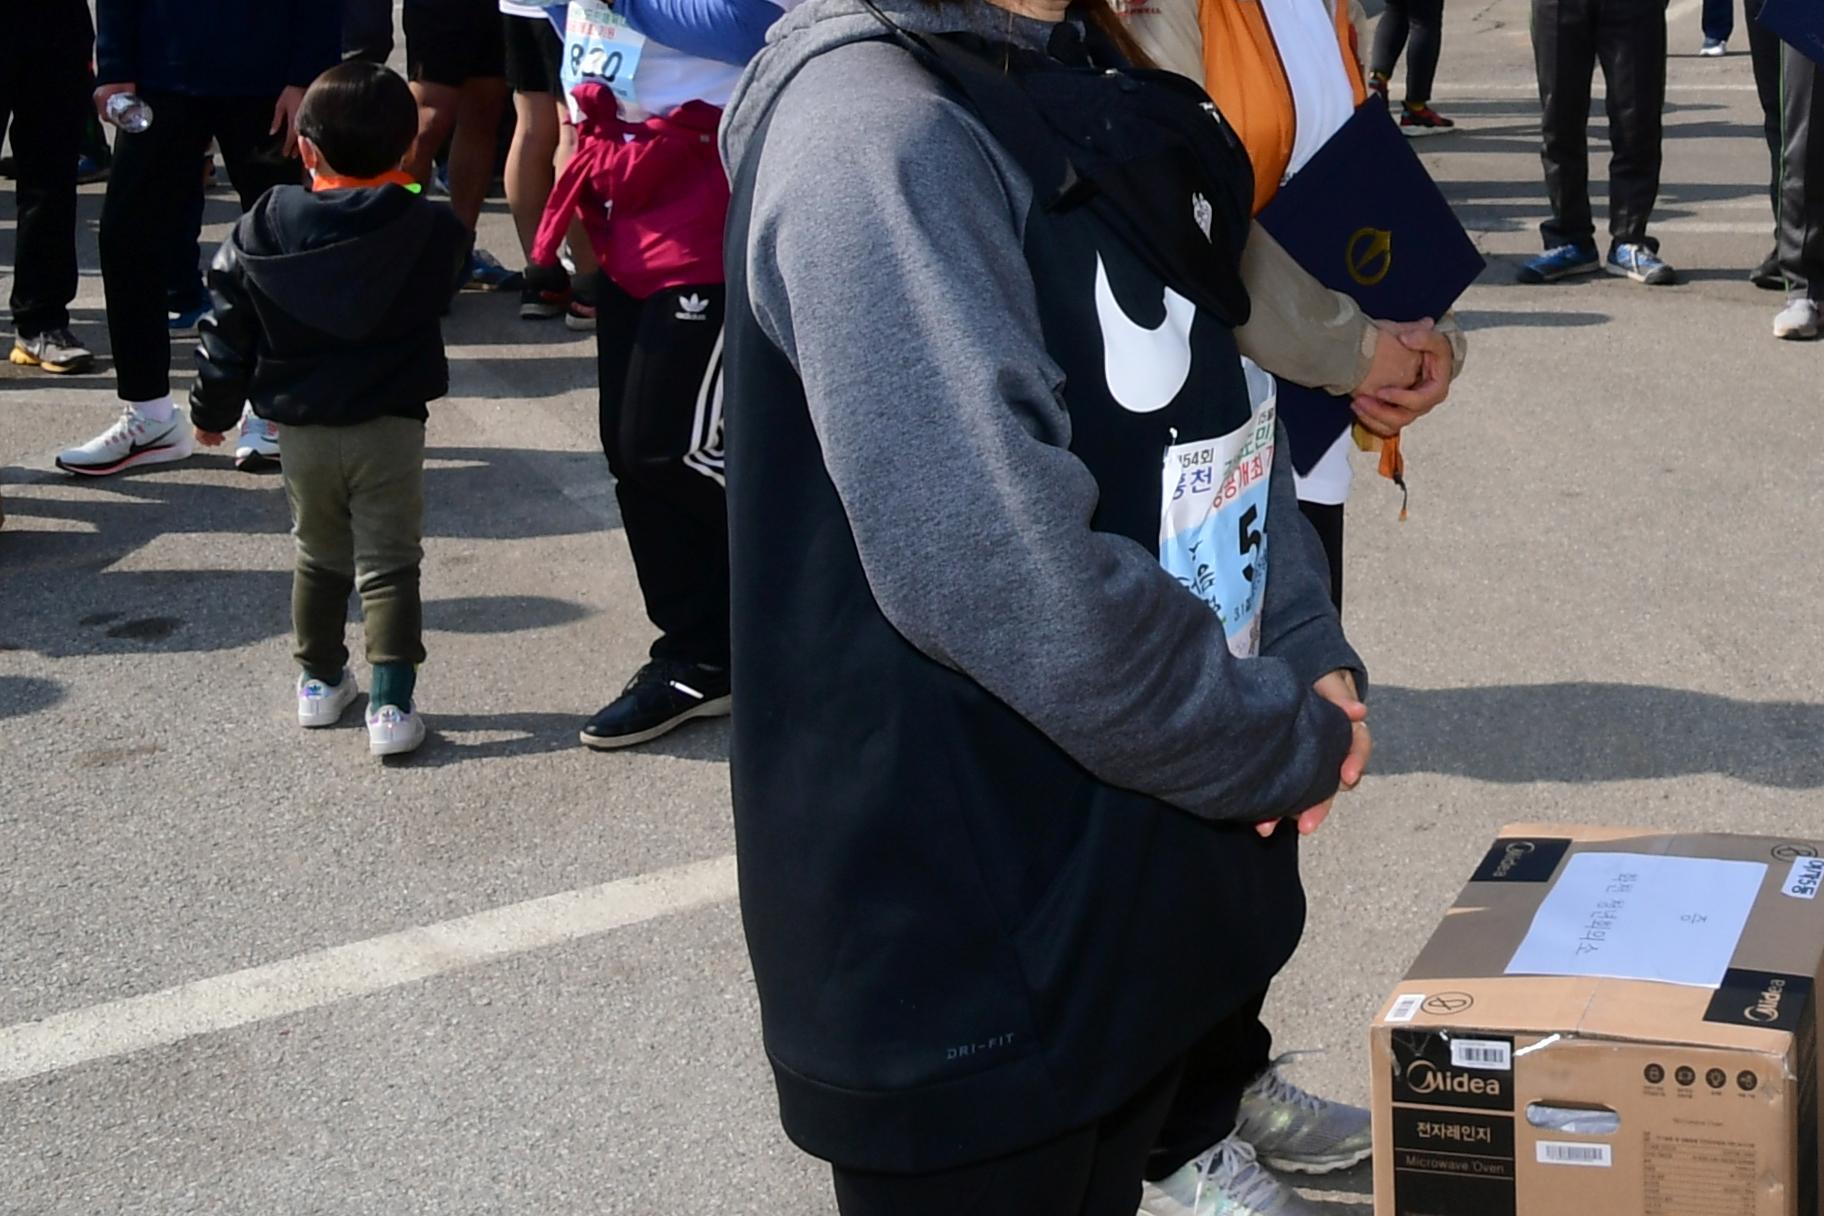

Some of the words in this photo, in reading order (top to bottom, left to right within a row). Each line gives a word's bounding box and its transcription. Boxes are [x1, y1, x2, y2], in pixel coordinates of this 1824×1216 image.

[1743, 979, 1786, 1022] Midea
[947, 1032, 1015, 1060] DRI-FIT
[1406, 1059, 1501, 1095] Midea
[1416, 1122, 1491, 1143] 전자레인지
[1406, 1155, 1468, 1171] Microwave
[1472, 1160, 1505, 1174] Oven
